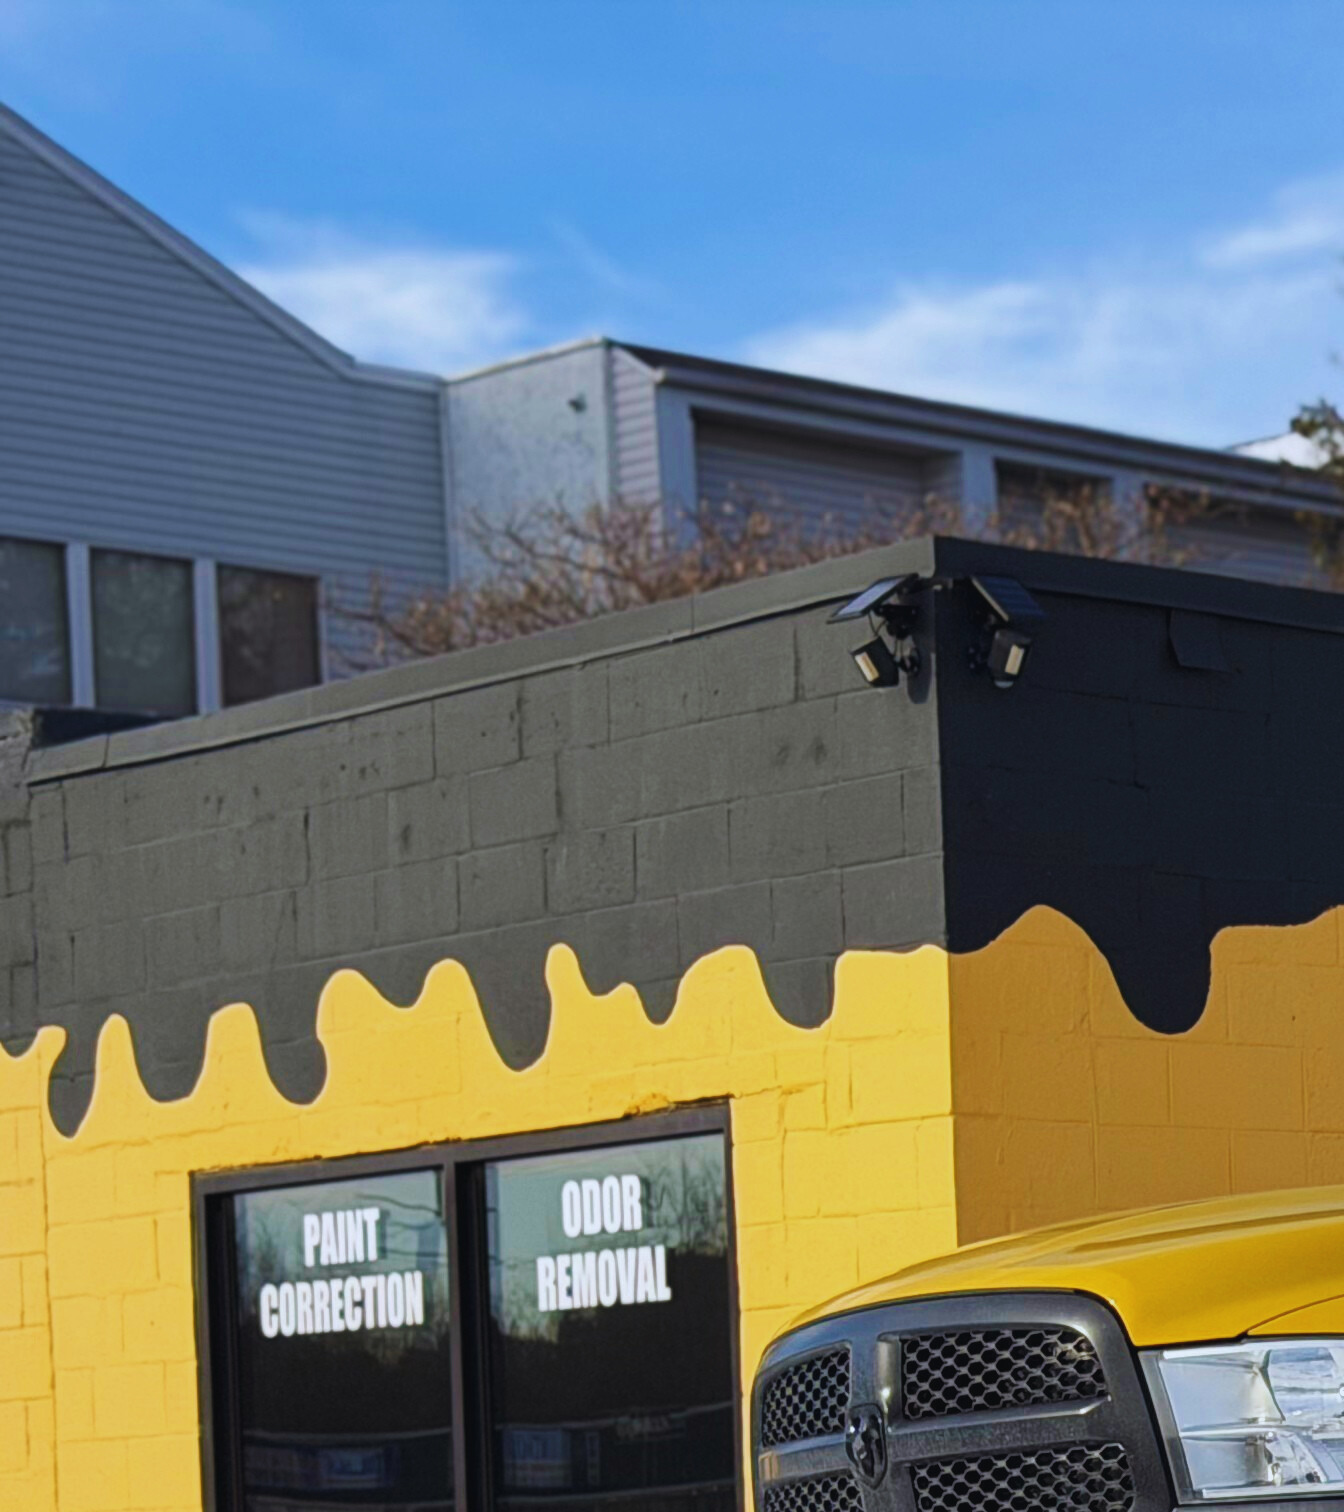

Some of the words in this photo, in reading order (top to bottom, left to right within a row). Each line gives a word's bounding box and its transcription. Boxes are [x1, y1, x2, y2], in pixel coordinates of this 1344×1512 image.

[303, 1208, 381, 1268] PAINT
[561, 1174, 643, 1237] ODOR
[259, 1271, 424, 1338] CORRECTION
[536, 1245, 671, 1312] REMOVAL
